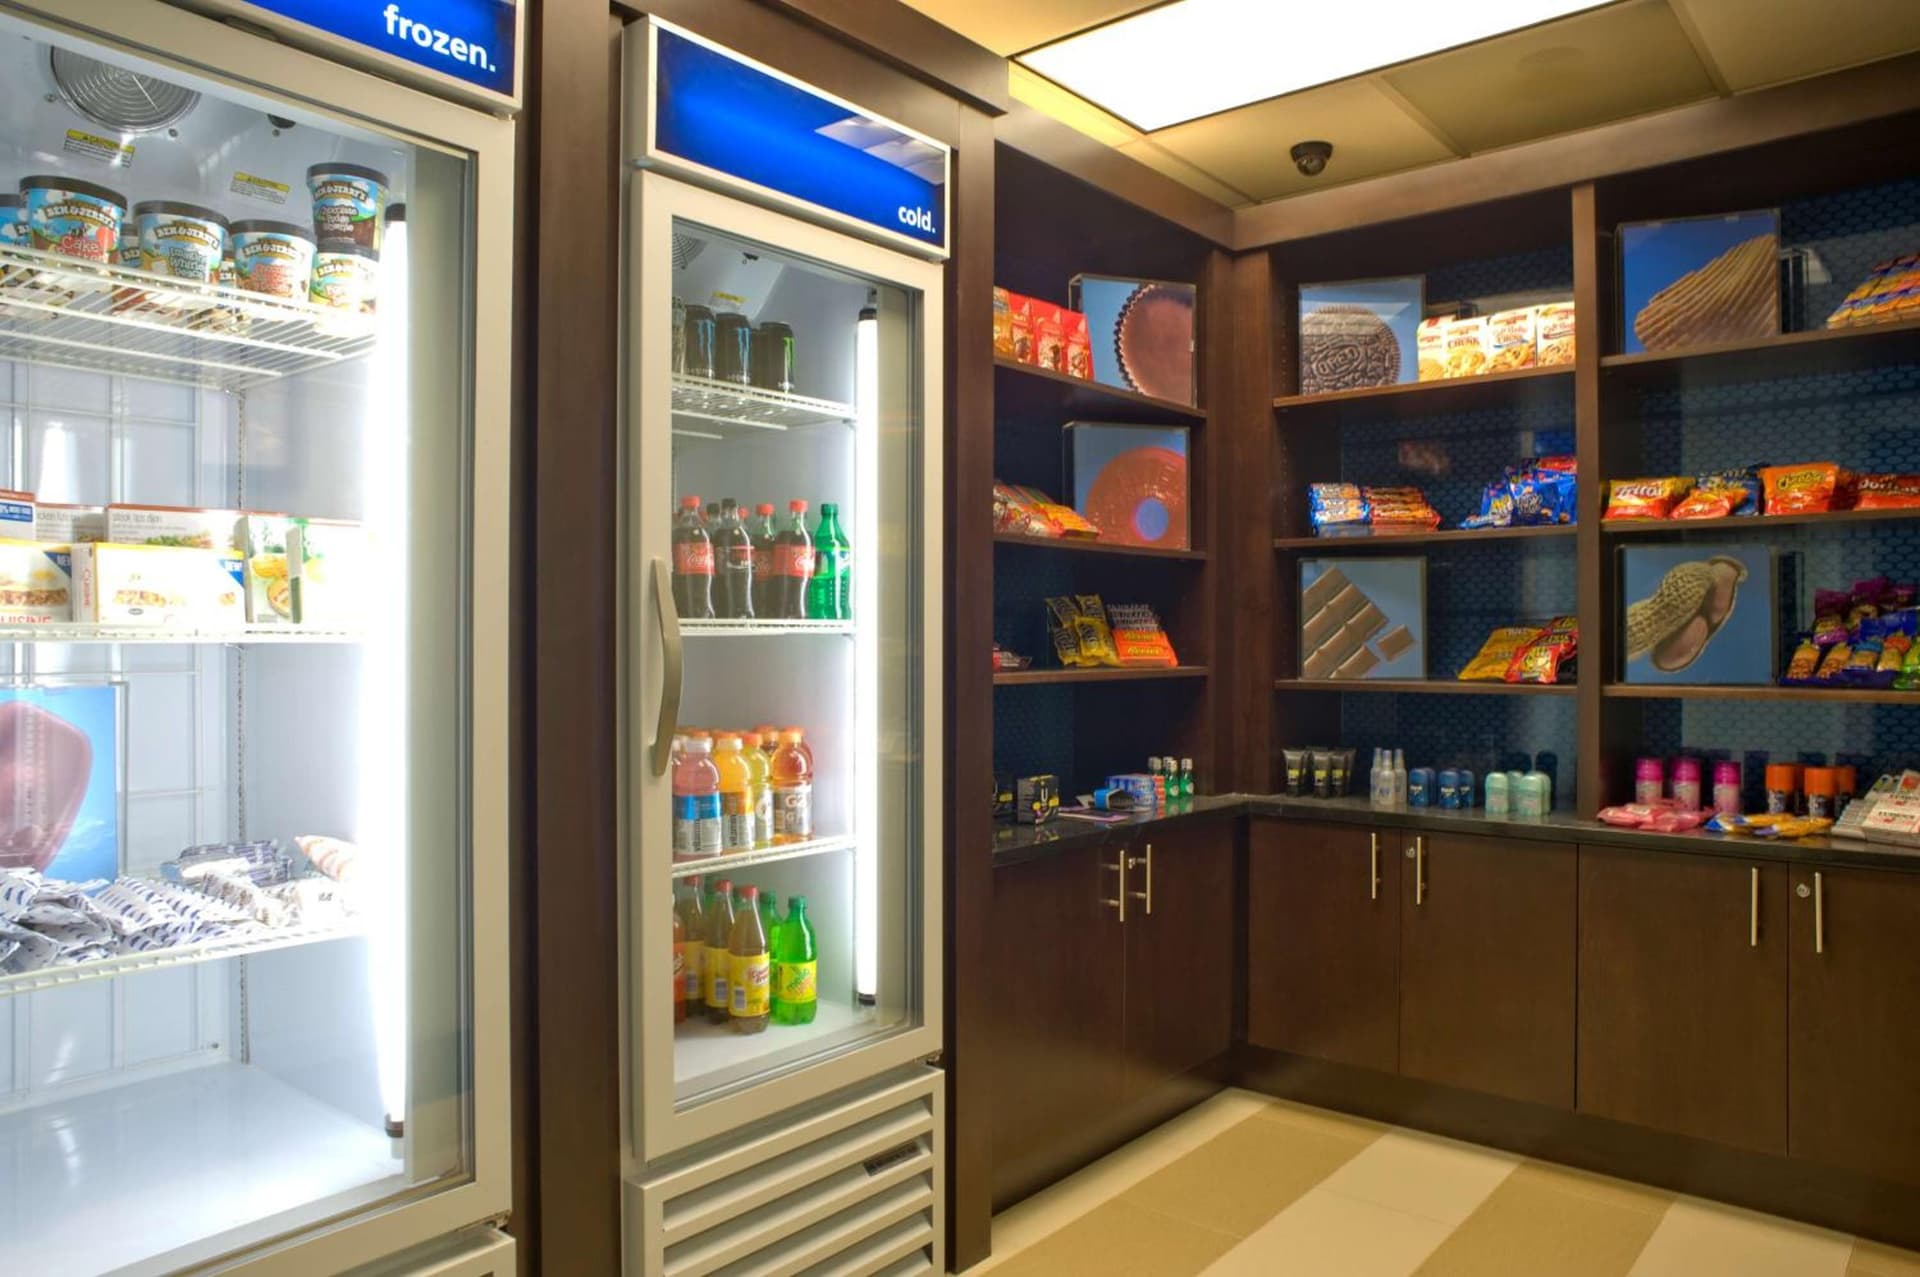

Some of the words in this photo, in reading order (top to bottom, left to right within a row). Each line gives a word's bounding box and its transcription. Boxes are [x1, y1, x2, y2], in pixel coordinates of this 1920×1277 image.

[383, 3, 496, 73] frozen.
[46, 205, 69, 219] BEN
[79, 207, 116, 230] JERRY'S
[898, 205, 936, 234] cold.
[62, 235, 98, 250] Cake
[156, 226, 178, 238] BEN
